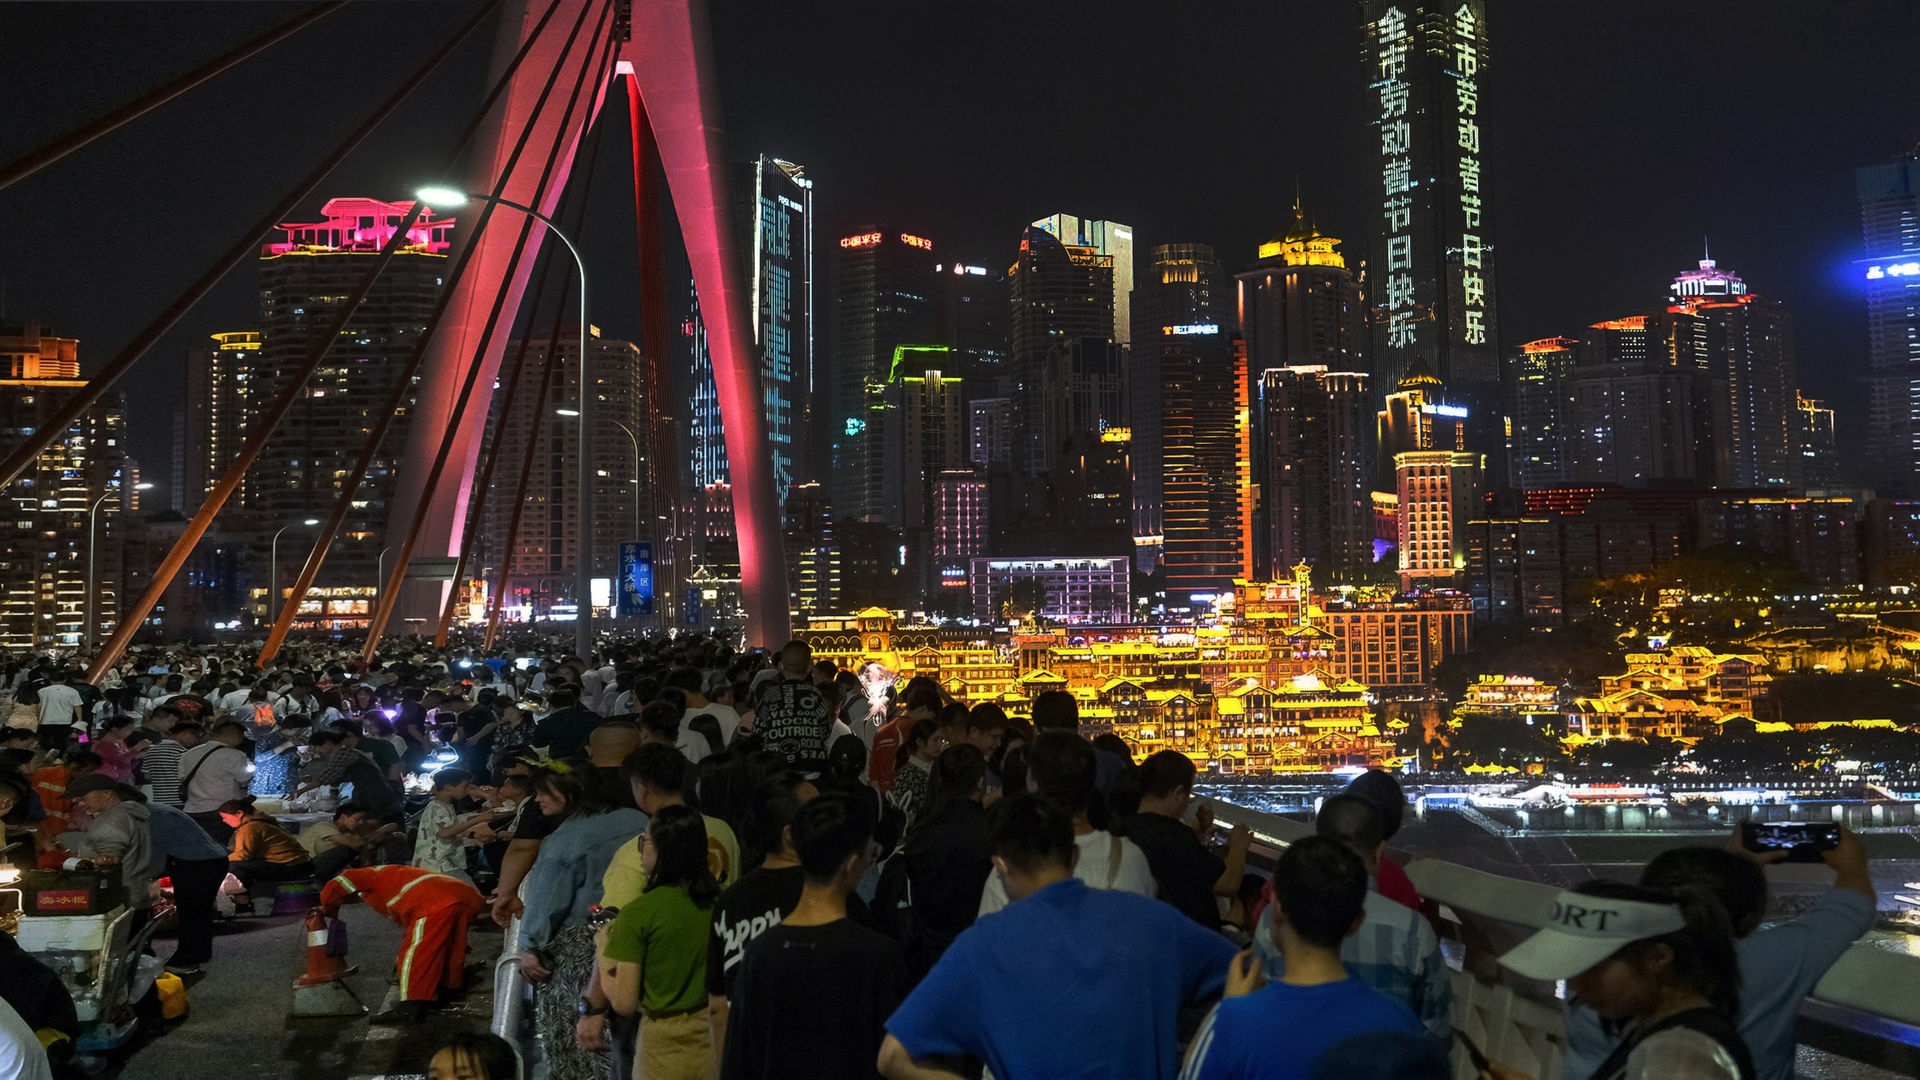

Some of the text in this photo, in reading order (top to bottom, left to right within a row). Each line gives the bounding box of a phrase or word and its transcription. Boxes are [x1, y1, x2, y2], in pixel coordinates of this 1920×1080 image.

[1454, 3, 1486, 345] 全市劳动者节日快乐
[840, 232, 882, 248] 中国平安
[624, 544, 636, 592] 东水门大桥
[640, 549, 649, 587] 南岸区
